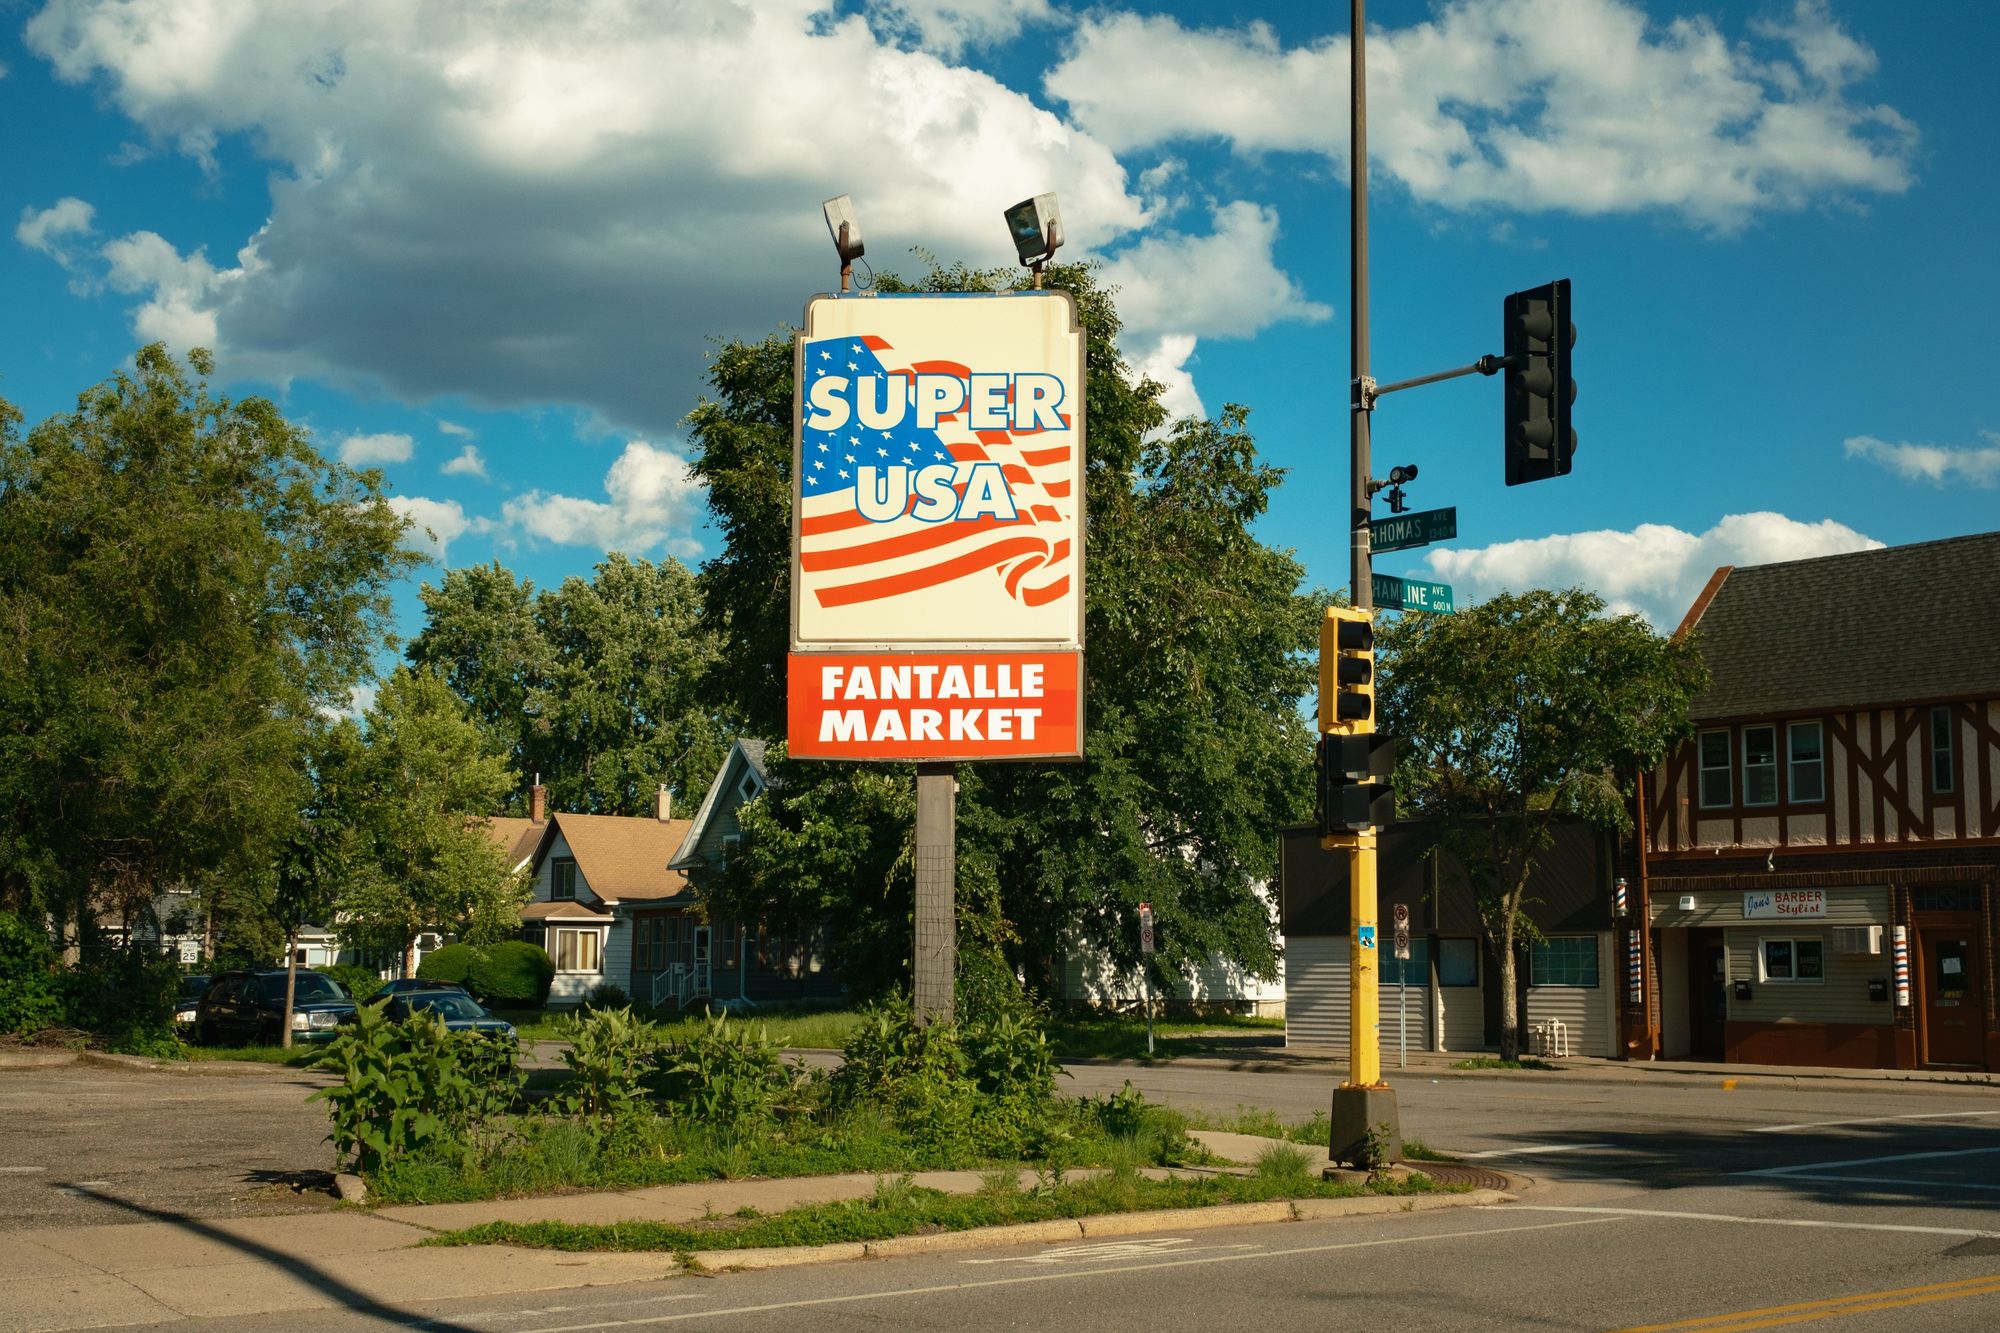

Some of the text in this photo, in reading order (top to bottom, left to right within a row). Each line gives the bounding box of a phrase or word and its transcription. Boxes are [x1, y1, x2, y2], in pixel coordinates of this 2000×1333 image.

[807, 372, 1071, 431] SUPER
[855, 463, 1019, 523] USA
[1432, 512, 1448, 523] AVE
[1373, 519, 1422, 544] THOMAS
[1373, 580, 1445, 605] HAMLINE AVE
[821, 664, 1044, 700] FANTALLE
[818, 708, 1042, 742] MARKET
[1775, 892, 1822, 903] BARBER
[1777, 904, 1820, 914] Stylist
[183, 952, 196, 960] 25
